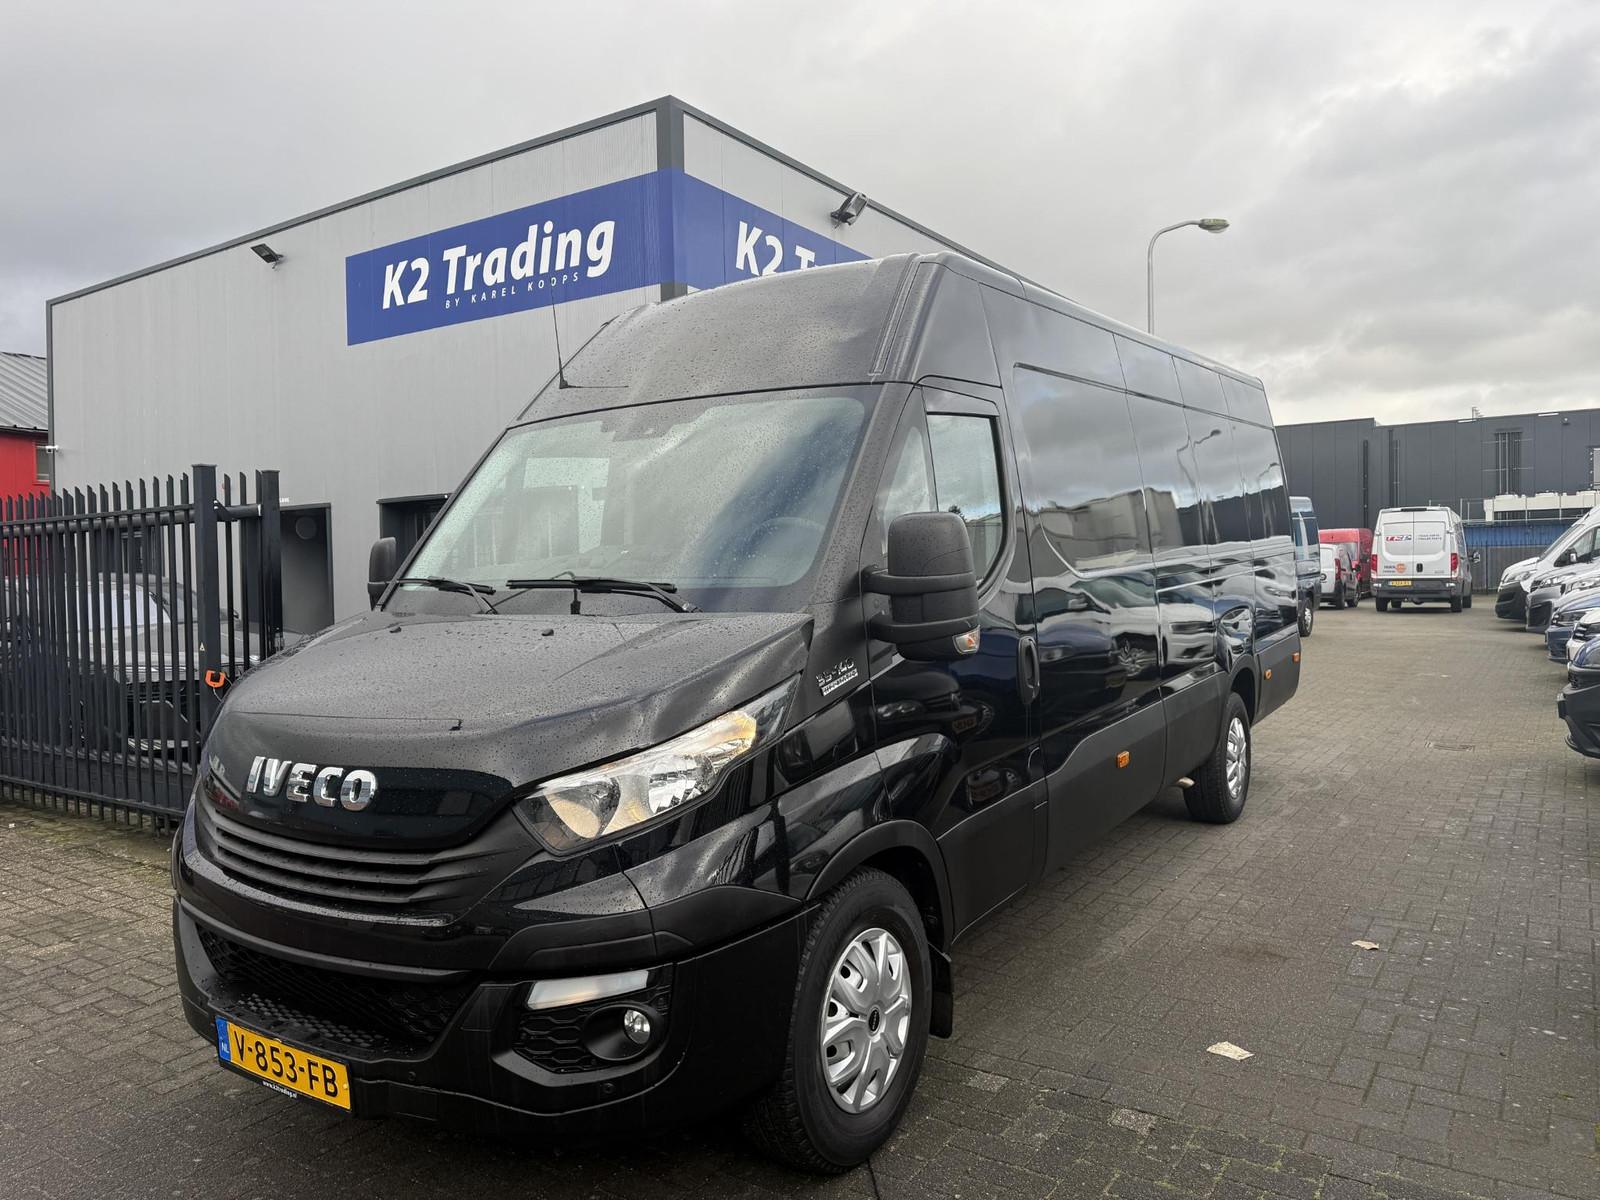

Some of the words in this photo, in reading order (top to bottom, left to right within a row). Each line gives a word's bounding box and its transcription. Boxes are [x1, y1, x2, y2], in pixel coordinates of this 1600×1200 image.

[382, 257, 430, 310] K2
[442, 220, 616, 295] Trading
[735, 220, 784, 277] K2
[794, 244, 819, 271] T
[445, 297, 460, 309] BY
[471, 285, 517, 304] KAREL
[527, 271, 579, 292] KOOPS
[246, 755, 379, 812] IVECO
[221, 1042, 230, 1054] NL
[234, 1030, 339, 1098] V-853-FB
